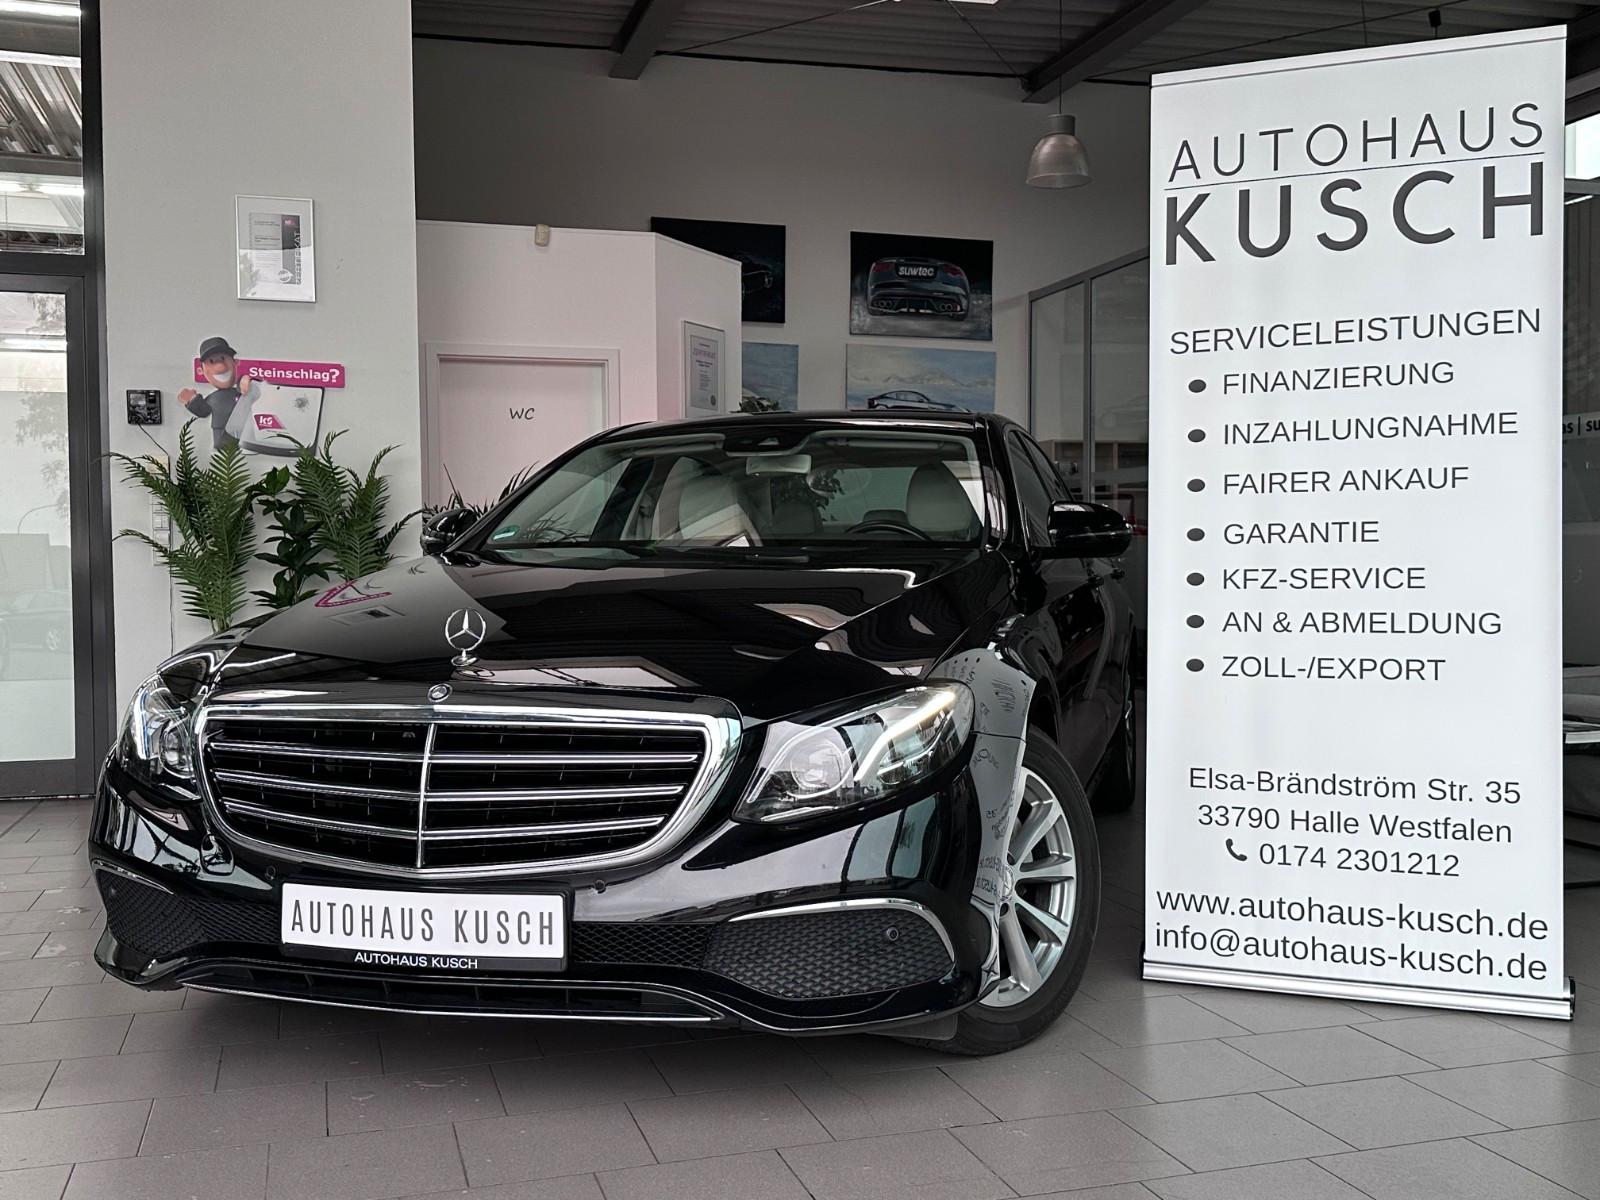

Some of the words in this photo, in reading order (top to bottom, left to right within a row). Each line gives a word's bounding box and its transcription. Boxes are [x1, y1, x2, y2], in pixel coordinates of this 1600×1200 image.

[1169, 102, 1543, 183] AUTOHAUS
[1166, 162, 1544, 266] KUSCH
[1170, 308, 1540, 355] SERVICELEISTUNGEN
[249, 367, 340, 383] Steinschlag?
[1223, 361, 1454, 395] FINANZIERUNG
[509, 407, 535, 421] WC
[1224, 411, 1518, 445] INZAHLUNGNAHME
[1224, 470, 1331, 495] FAIRER
[1339, 466, 1469, 492] ANKAUF
[1223, 520, 1380, 545] GARANTIE
[1223, 567, 1426, 590] KFZ-SERVICE
[1222, 611, 1262, 633] AN
[1273, 611, 1292, 633] &
[1300, 612, 1501, 635] ABMELDUNG
[1222, 655, 1446, 681] ZOLL-/EXPORT
[1190, 768, 1416, 800] Elsa-Brändström
[1428, 779, 1473, 802] Str.
[1485, 781, 1521, 804] 35
[1198, 804, 1280, 830] 33790
[1290, 809, 1360, 835] Halle
[1368, 813, 1512, 843] Westfalen
[1259, 843, 1327, 868] 0174
[1336, 848, 1460, 877] 2301212
[291, 899, 434, 942] AUTOHAUS
[454, 909, 553, 945] KUSCH
[1156, 891, 1548, 940] www.autohaus-kusch.de
[354, 951, 428, 967] AUTOHAUS
[431, 957, 478, 969] KUSCH
[1156, 922, 1547, 981] info@autohaus-kusch.de
